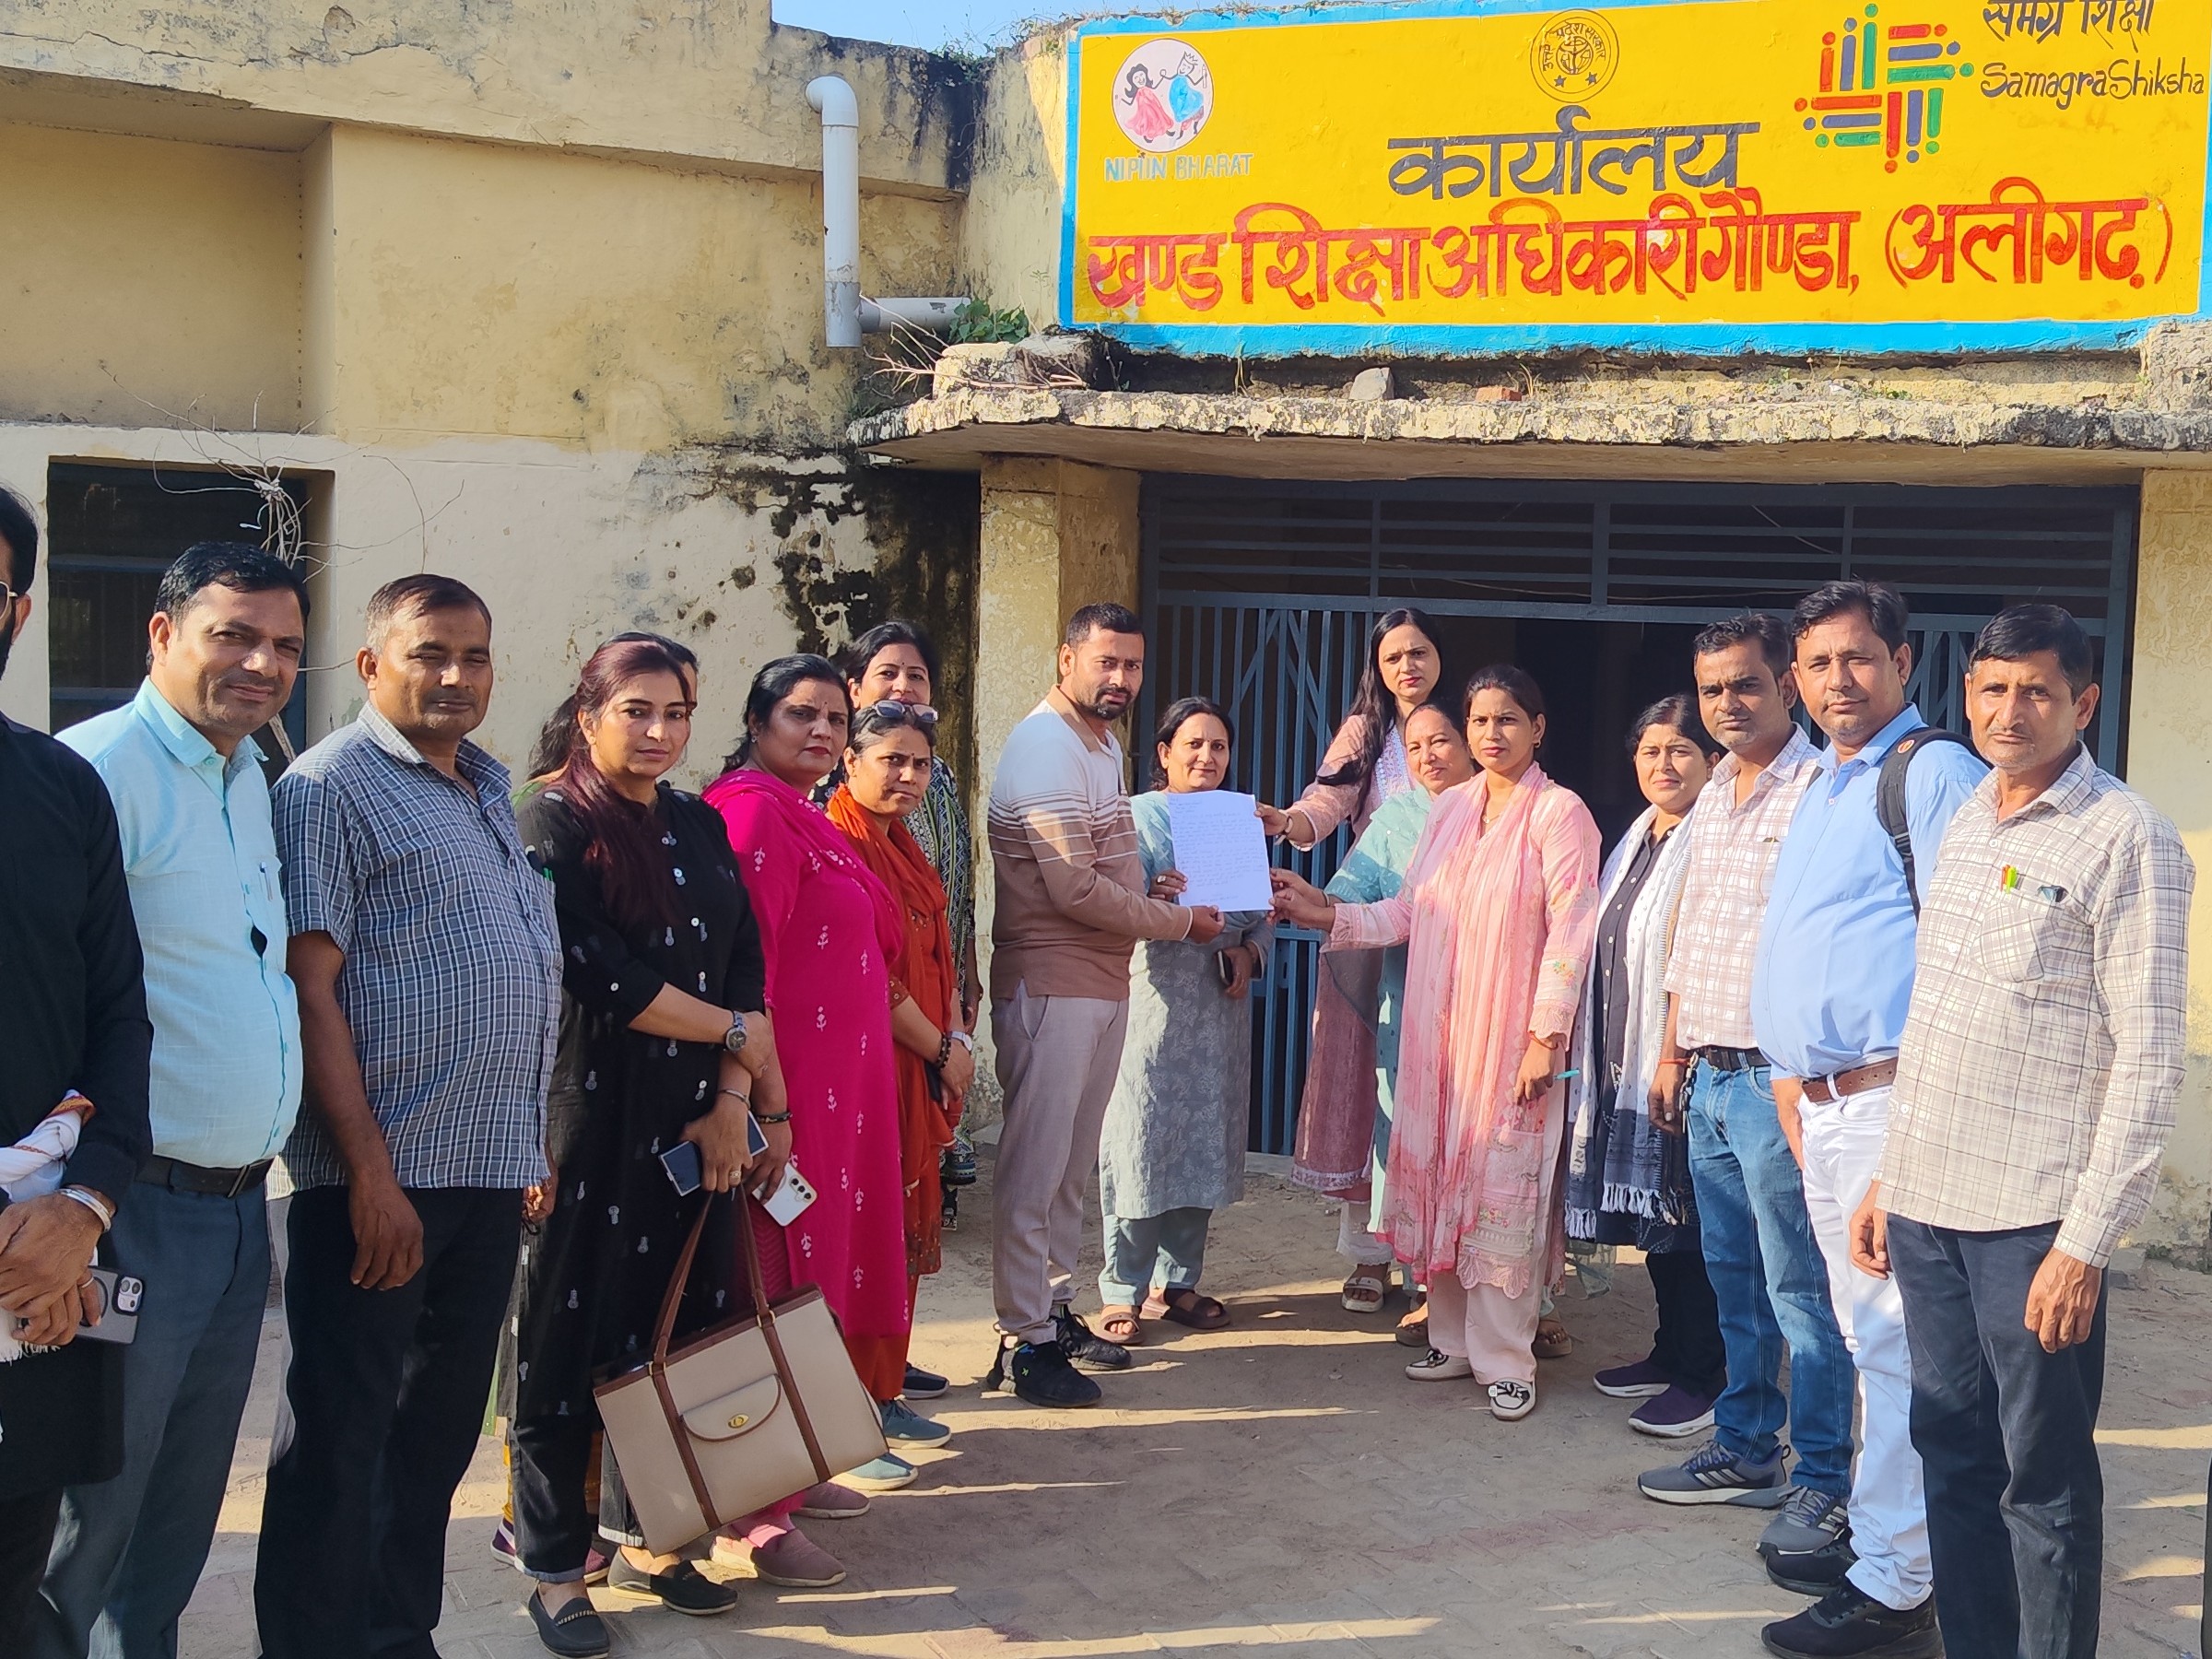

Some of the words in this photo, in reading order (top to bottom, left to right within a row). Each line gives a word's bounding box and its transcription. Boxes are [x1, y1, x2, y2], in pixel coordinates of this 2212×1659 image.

[1983, 0, 2075, 44] समग्र
[1176, 153, 1253, 180] BHARAT
[1387, 105, 1760, 200] कार्यालय
[1088, 231, 1227, 312] खण्ड
[1231, 202, 1431, 317] शिक्षा
